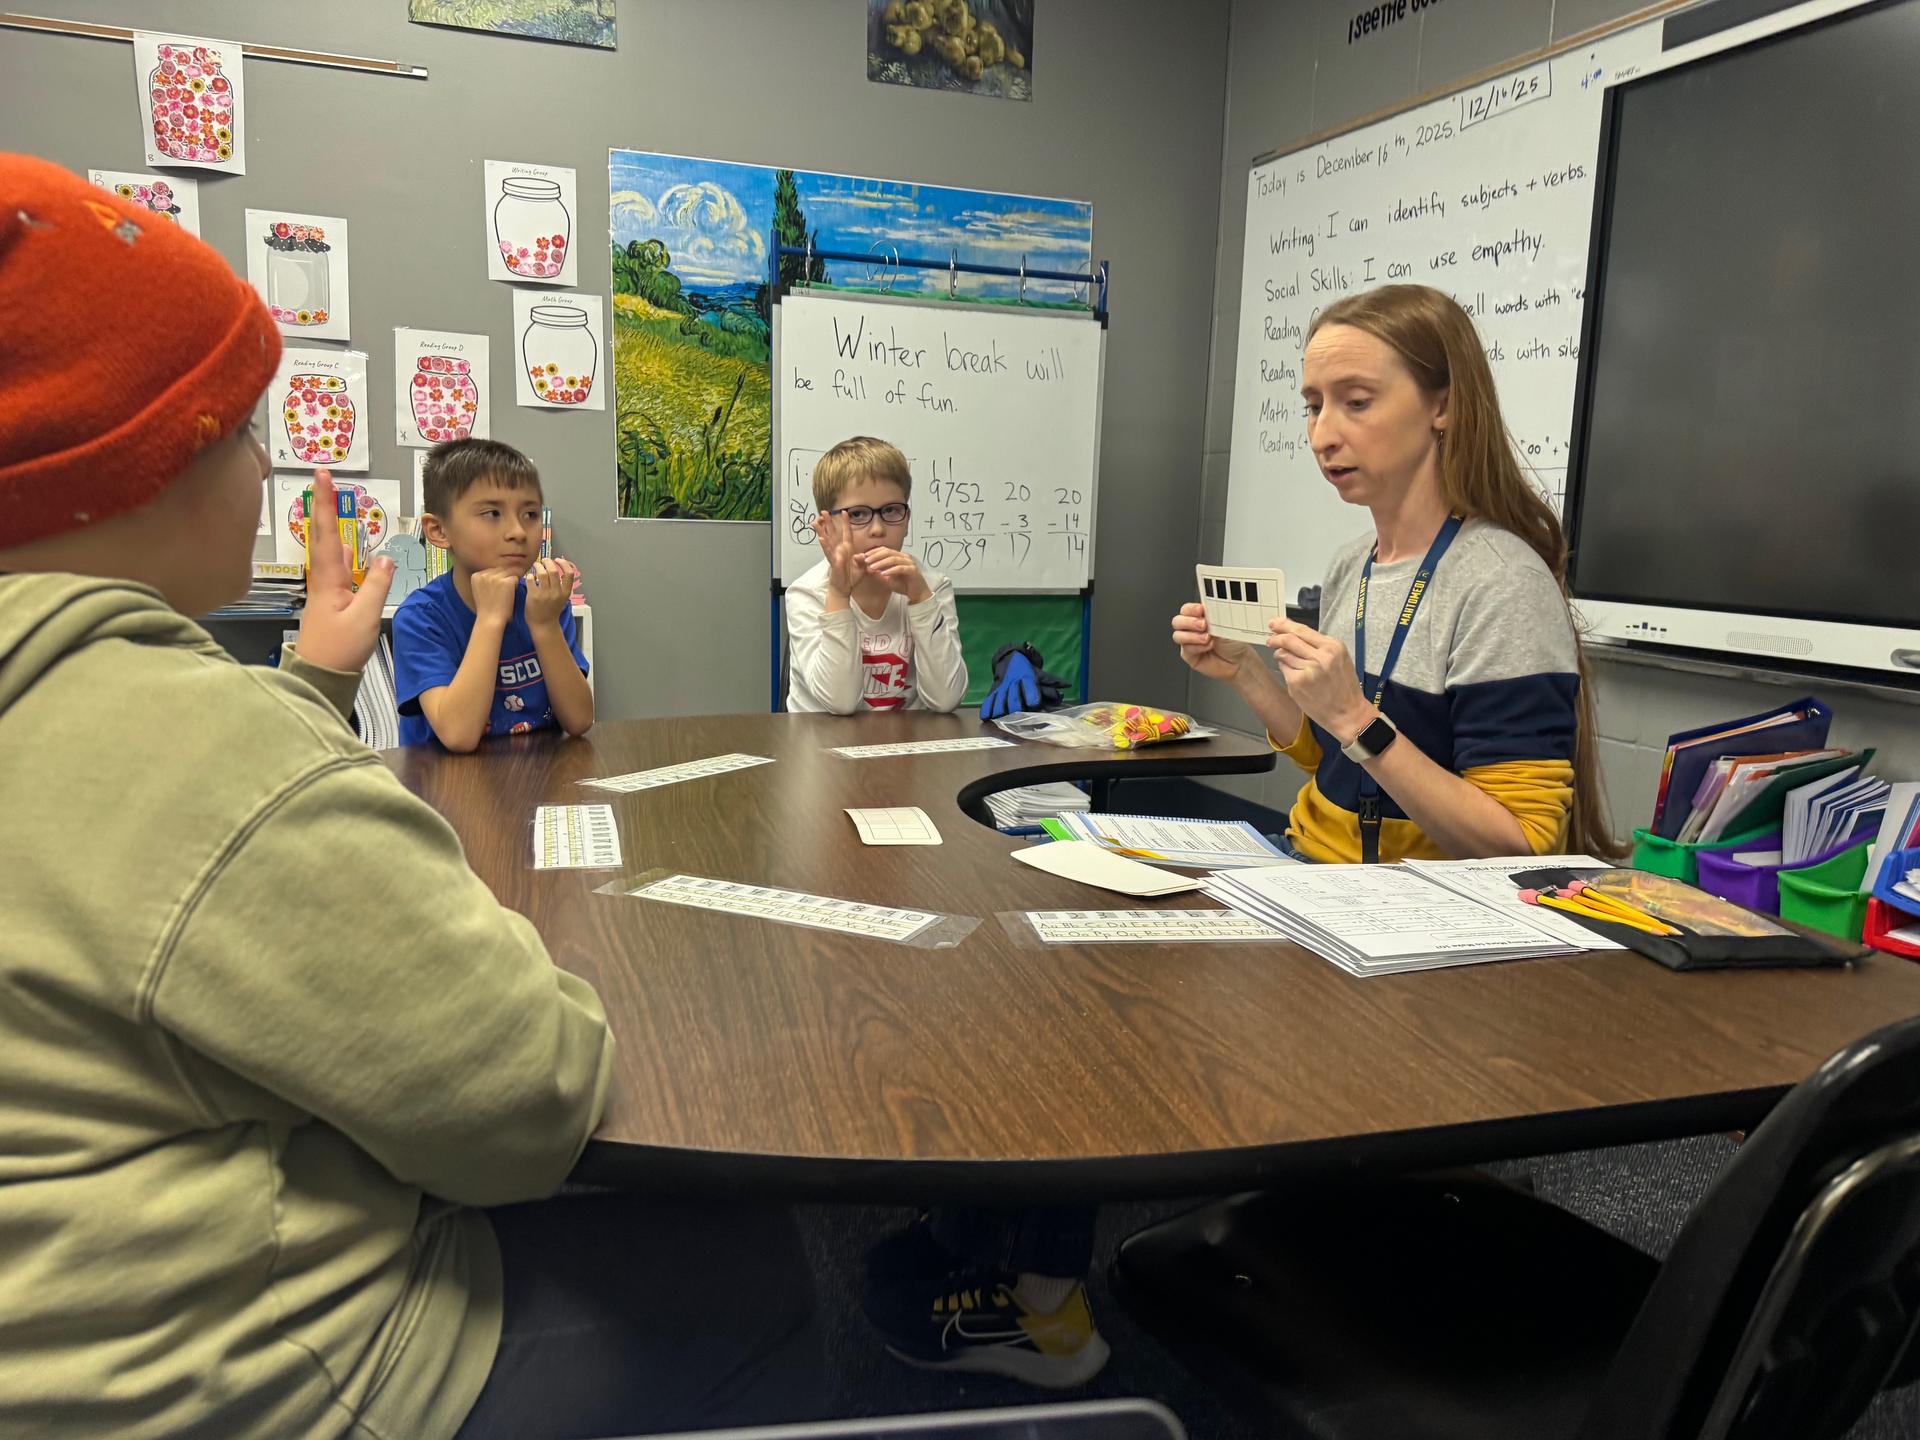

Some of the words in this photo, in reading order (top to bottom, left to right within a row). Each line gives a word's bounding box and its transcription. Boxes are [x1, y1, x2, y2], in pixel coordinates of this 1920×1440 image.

[1469, 76, 1539, 120] 12/16/25
[1256, 171, 1287, 198] Today
[1297, 170, 1305, 183] is
[1316, 147, 1374, 179] December
[1415, 120, 1456, 148] 2025.
[1327, 211, 1339, 239] I
[1349, 218, 1368, 232] can
[1388, 191, 1445, 223] identify
[1461, 179, 1518, 210] subjects
[1526, 178, 1537, 191] +
[1543, 163, 1587, 187] verbs.
[1264, 272, 1300, 302] Social
[1363, 257, 1376, 282] I
[1387, 262, 1412, 279] can
[1429, 250, 1458, 270] use
[1472, 228, 1545, 267] empathy.
[1264, 315, 1302, 350] Reading
[1495, 293, 1529, 315] words
[1535, 288, 1560, 308] with
[293, 359, 316, 368] Reading
[316, 360, 333, 369] Group
[420, 341, 441, 351] Reading
[441, 342, 458, 351] Group
[833, 315, 926, 369] Winter
[944, 331, 1008, 374] break
[1026, 347, 1064, 382] will
[1260, 359, 1297, 390] Reading
[1517, 337, 1550, 360] with
[794, 366, 814, 391] be
[832, 368, 867, 400] full
[885, 379, 906, 404] of
[916, 382, 959, 413] fun.
[1259, 431, 1295, 460] Reading
[282, 480, 290, 491] C
[929, 478, 985, 508] 9752
[1005, 482, 1031, 501] 20
[1054, 488, 1082, 504] 20
[944, 511, 985, 531] 987
[257, 564, 298, 576] SOCIAL
[1067, 534, 1084, 571] 14
[1399, 579, 1426, 626] MAHTOMEDI
